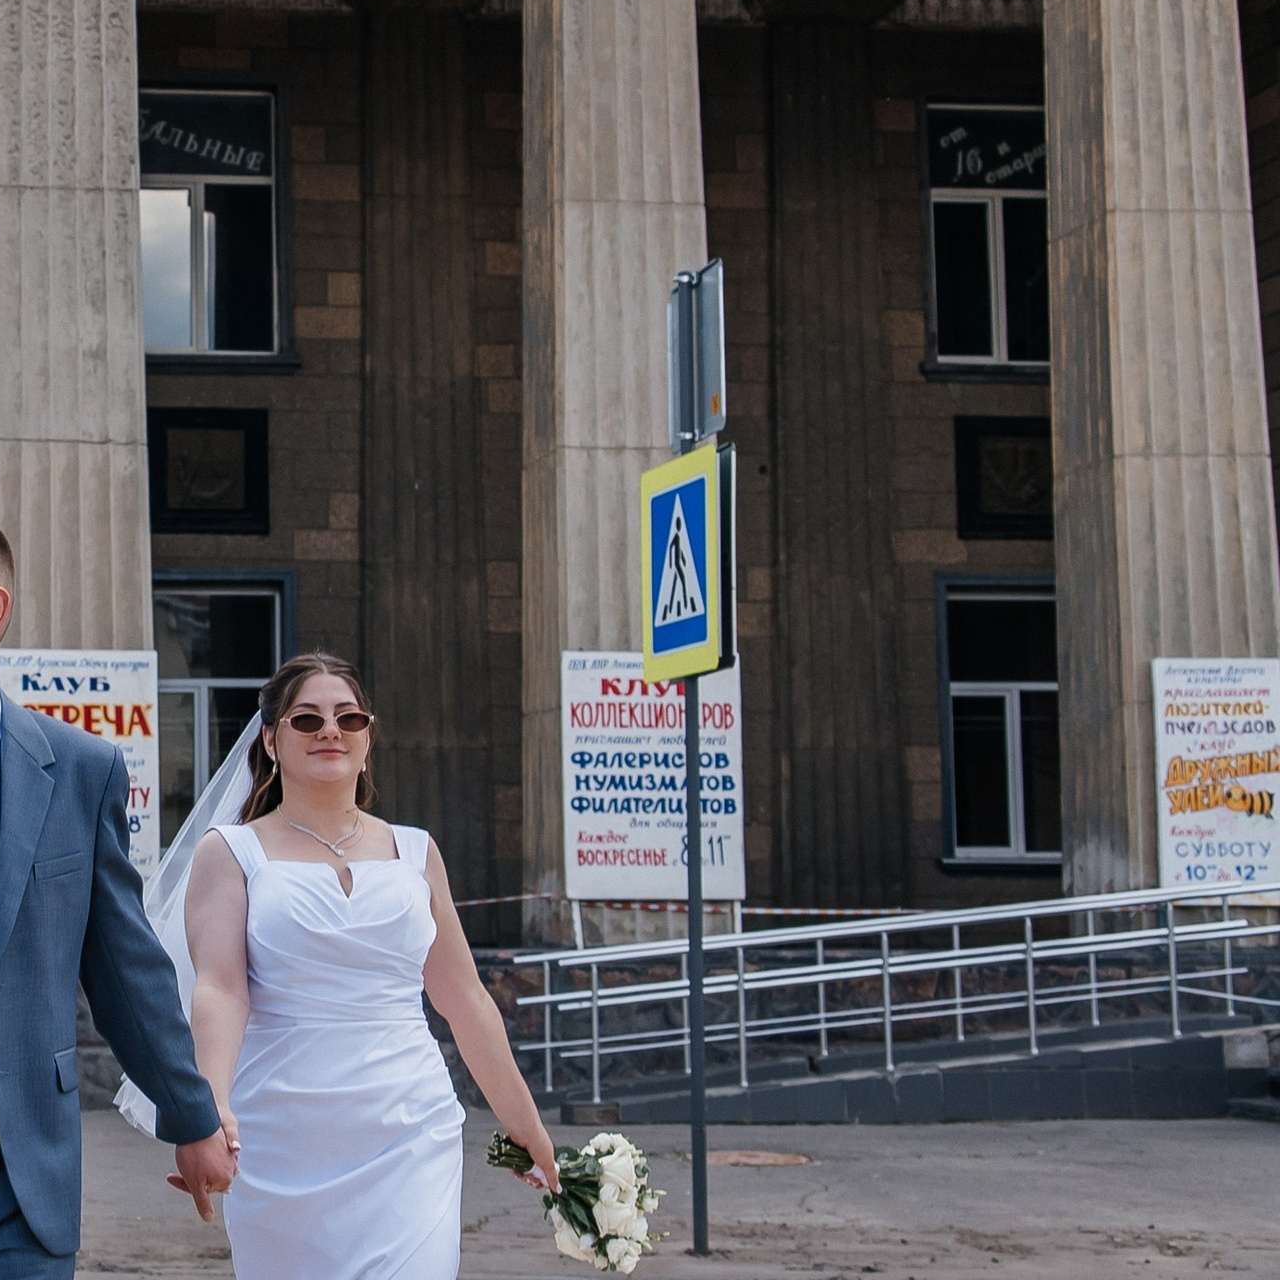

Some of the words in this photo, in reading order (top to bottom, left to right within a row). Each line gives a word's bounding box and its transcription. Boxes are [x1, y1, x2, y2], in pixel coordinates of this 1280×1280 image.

[612, 659, 644, 671] Луганс
[22, 672, 111, 695] КЛУБ
[570, 702, 734, 730] КОЛЛЕКЦИОНРОВ
[570, 751, 730, 769] ФАЛЕРИСОВ
[570, 796, 738, 815] ФИЛАТЕЛИТОВ
[577, 830, 629, 844] Каждое
[577, 848, 669, 867] ВОСКРЕСЕНЬЕ
[1174, 841, 1272, 858] СУББОТУ
